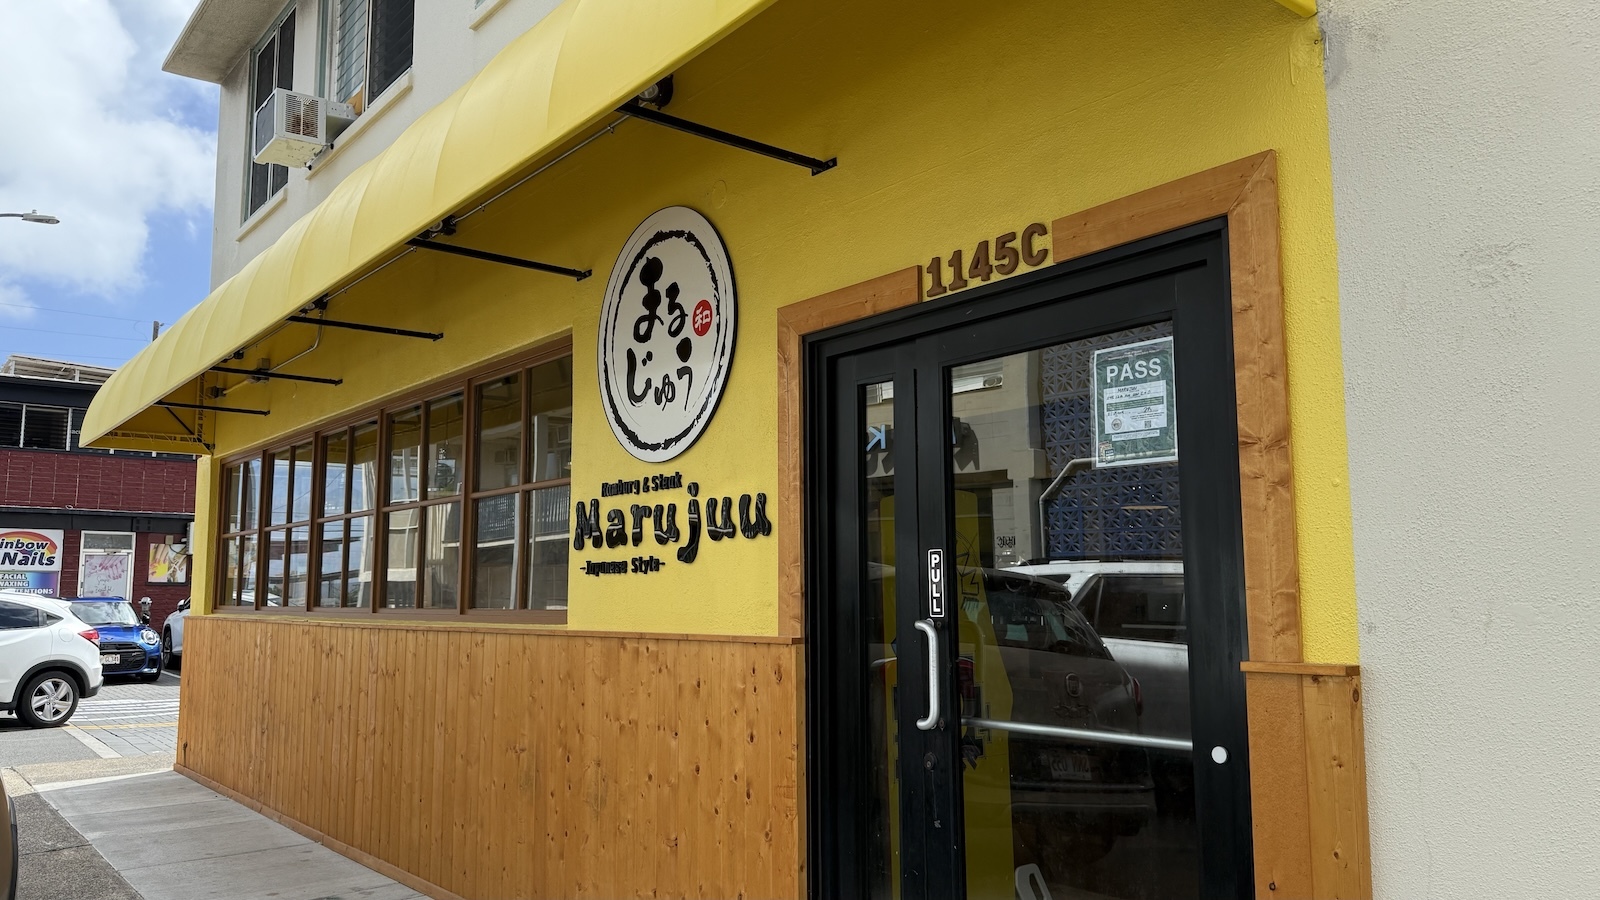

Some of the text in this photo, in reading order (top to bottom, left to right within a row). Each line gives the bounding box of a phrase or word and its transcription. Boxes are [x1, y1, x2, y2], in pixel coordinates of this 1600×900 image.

[926, 222, 1049, 298] 1145C
[693, 306, 712, 332] 和
[1106, 357, 1162, 383] PASS
[642, 476, 650, 492] &
[652, 471, 682, 491] Steak
[573, 482, 772, 564] Marujuu
[1, 552, 56, 566] Nails
[931, 554, 943, 613] PULL
